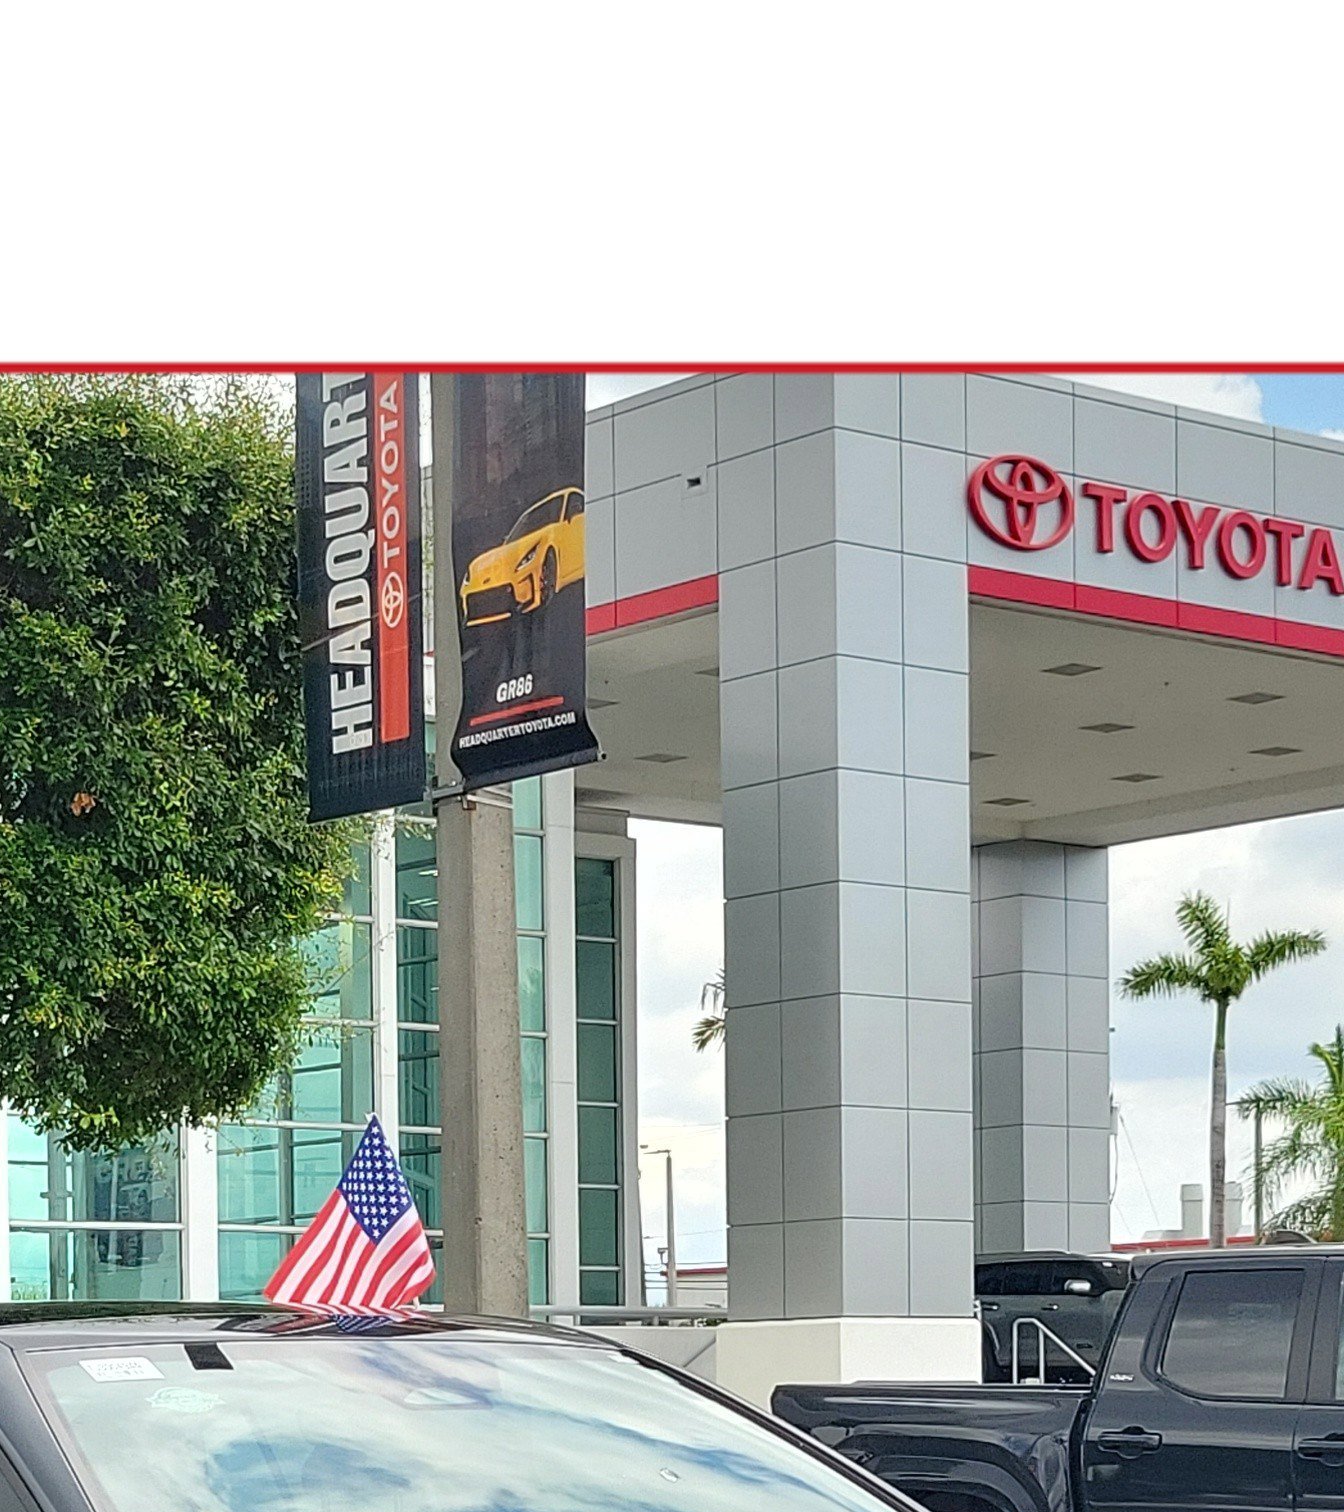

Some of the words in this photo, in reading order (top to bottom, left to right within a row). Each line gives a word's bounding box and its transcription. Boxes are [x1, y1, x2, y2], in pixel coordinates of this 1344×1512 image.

[380, 380, 401, 569] TOYOTA
[496, 673, 534, 703] GR86
[458, 711, 577, 749] HEADQUARTERTOYOTA.COM
